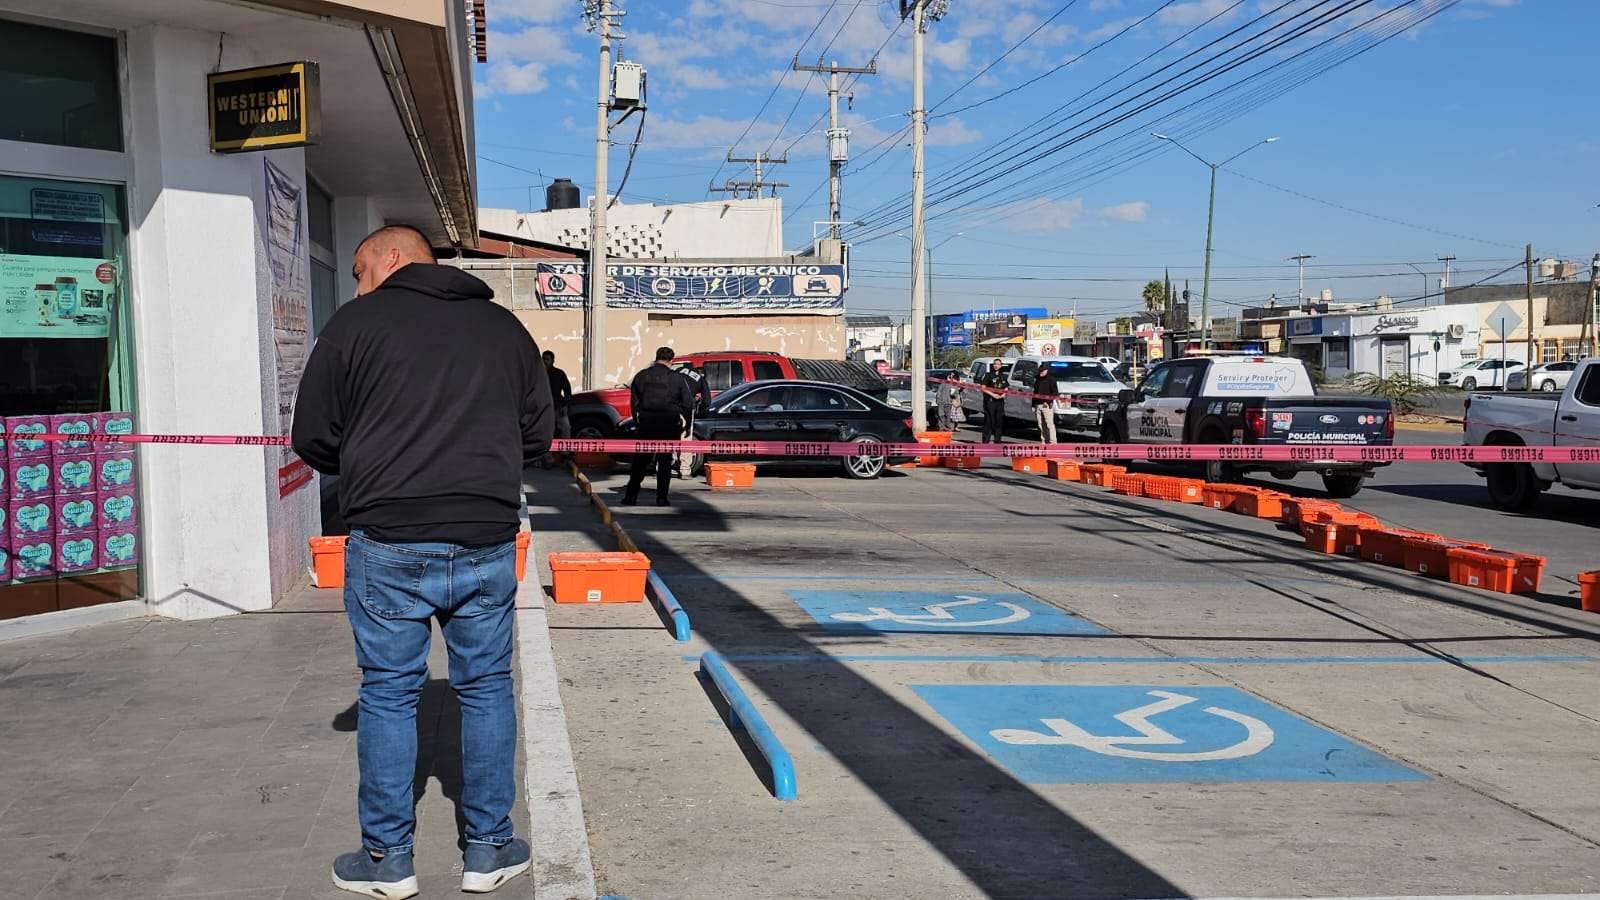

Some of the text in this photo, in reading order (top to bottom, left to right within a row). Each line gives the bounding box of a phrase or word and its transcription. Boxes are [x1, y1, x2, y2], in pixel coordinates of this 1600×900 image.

[217, 89, 288, 111] WESTERN
[240, 105, 288, 125] UNION
[555, 265, 821, 276] TALR DE SERVICIO MECANICO
[1218, 374, 1243, 382] Servir
[1252, 374, 1288, 383] Proteger
[1140, 427, 1172, 437] MUNICIPAL
[1288, 432, 1321, 440] POLICÍA
[152, 435, 203, 443] PELIGRO
[235, 436, 286, 445] PELIGRO
[557, 441, 606, 451] PELIGRO
[710, 443, 756, 454] PELIGRO
[785, 443, 830, 455] PELIGRO
[930, 445, 975, 456] PELIGRO
[1003, 445, 1047, 457] PELIGRO
[1075, 446, 1119, 457] PELIGRO
[1147, 447, 1191, 458] PELIGRO
[1219, 447, 1263, 458] PELIGRO
[1290, 448, 1334, 459] PELIGRO
[1361, 448, 1404, 459] PELIGRO
[1431, 448, 1474, 460] PELIGRO
[1501, 448, 1544, 460] PELIGRO
